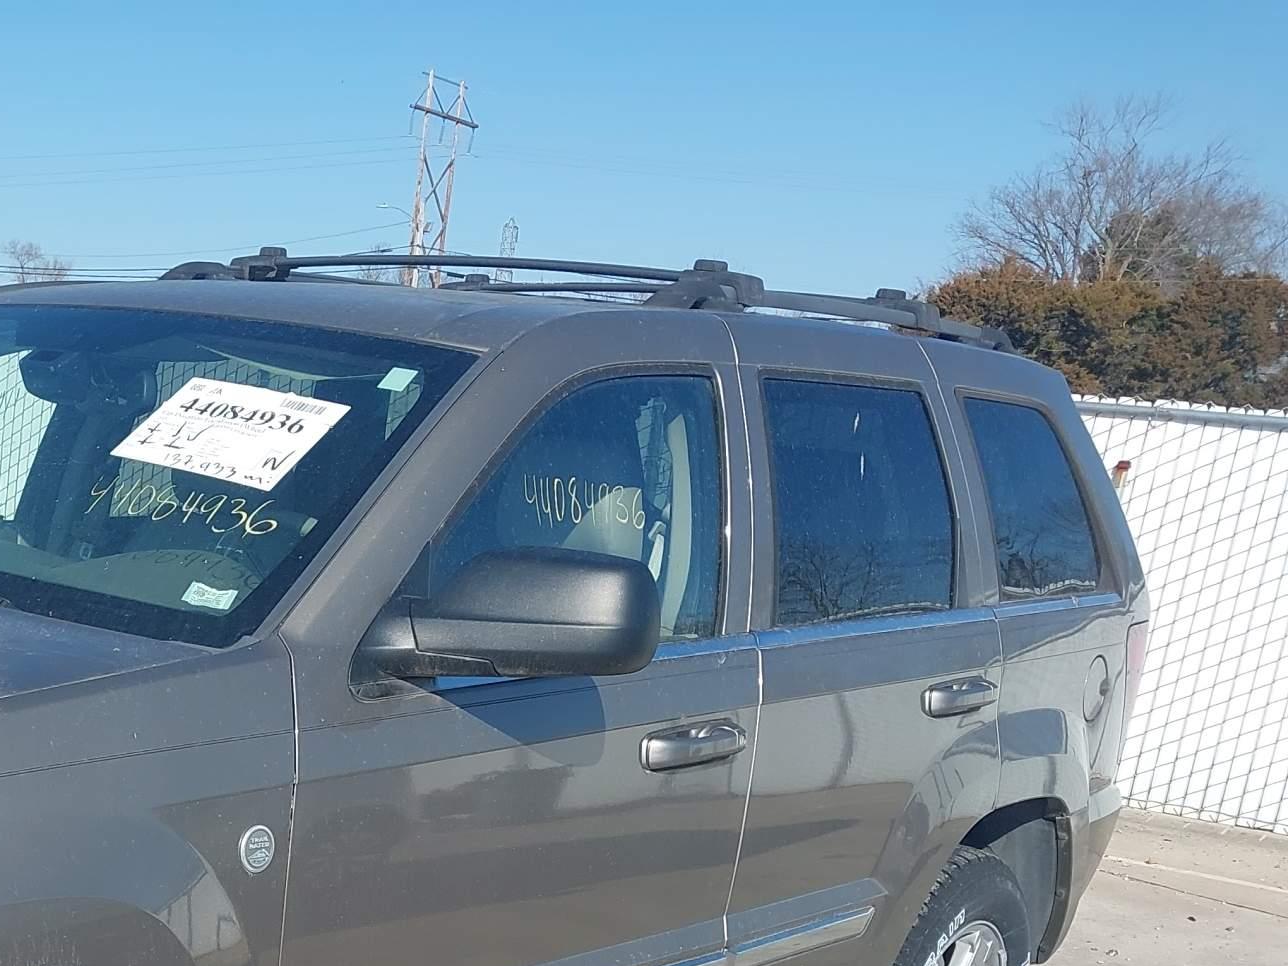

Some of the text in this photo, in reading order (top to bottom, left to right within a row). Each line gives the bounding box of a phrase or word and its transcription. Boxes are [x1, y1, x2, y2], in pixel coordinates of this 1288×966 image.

[180, 398, 305, 434] 44084936
[84, 476, 279, 538] 44084936
[523, 472, 646, 530] 44084936
